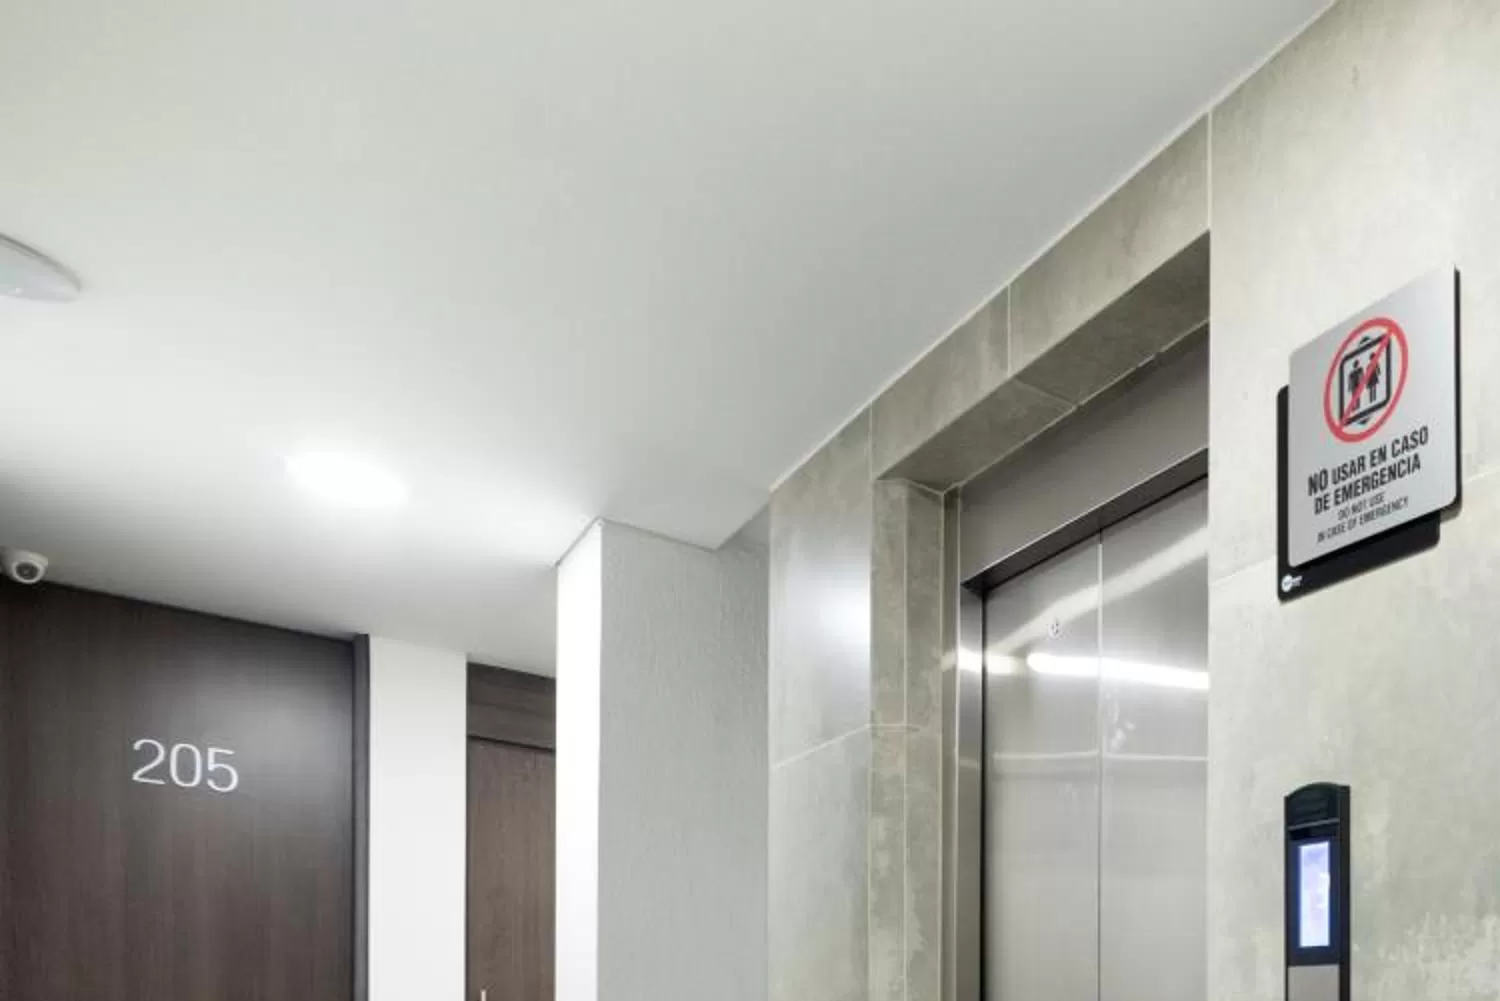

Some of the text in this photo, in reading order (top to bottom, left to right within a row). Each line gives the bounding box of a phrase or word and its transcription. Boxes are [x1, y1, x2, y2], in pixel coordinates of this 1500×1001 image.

[1307, 425, 1429, 497] NO USAR EN CASO
[1314, 452, 1421, 515] DE EMERGENCIA
[131, 738, 240, 793] 205
